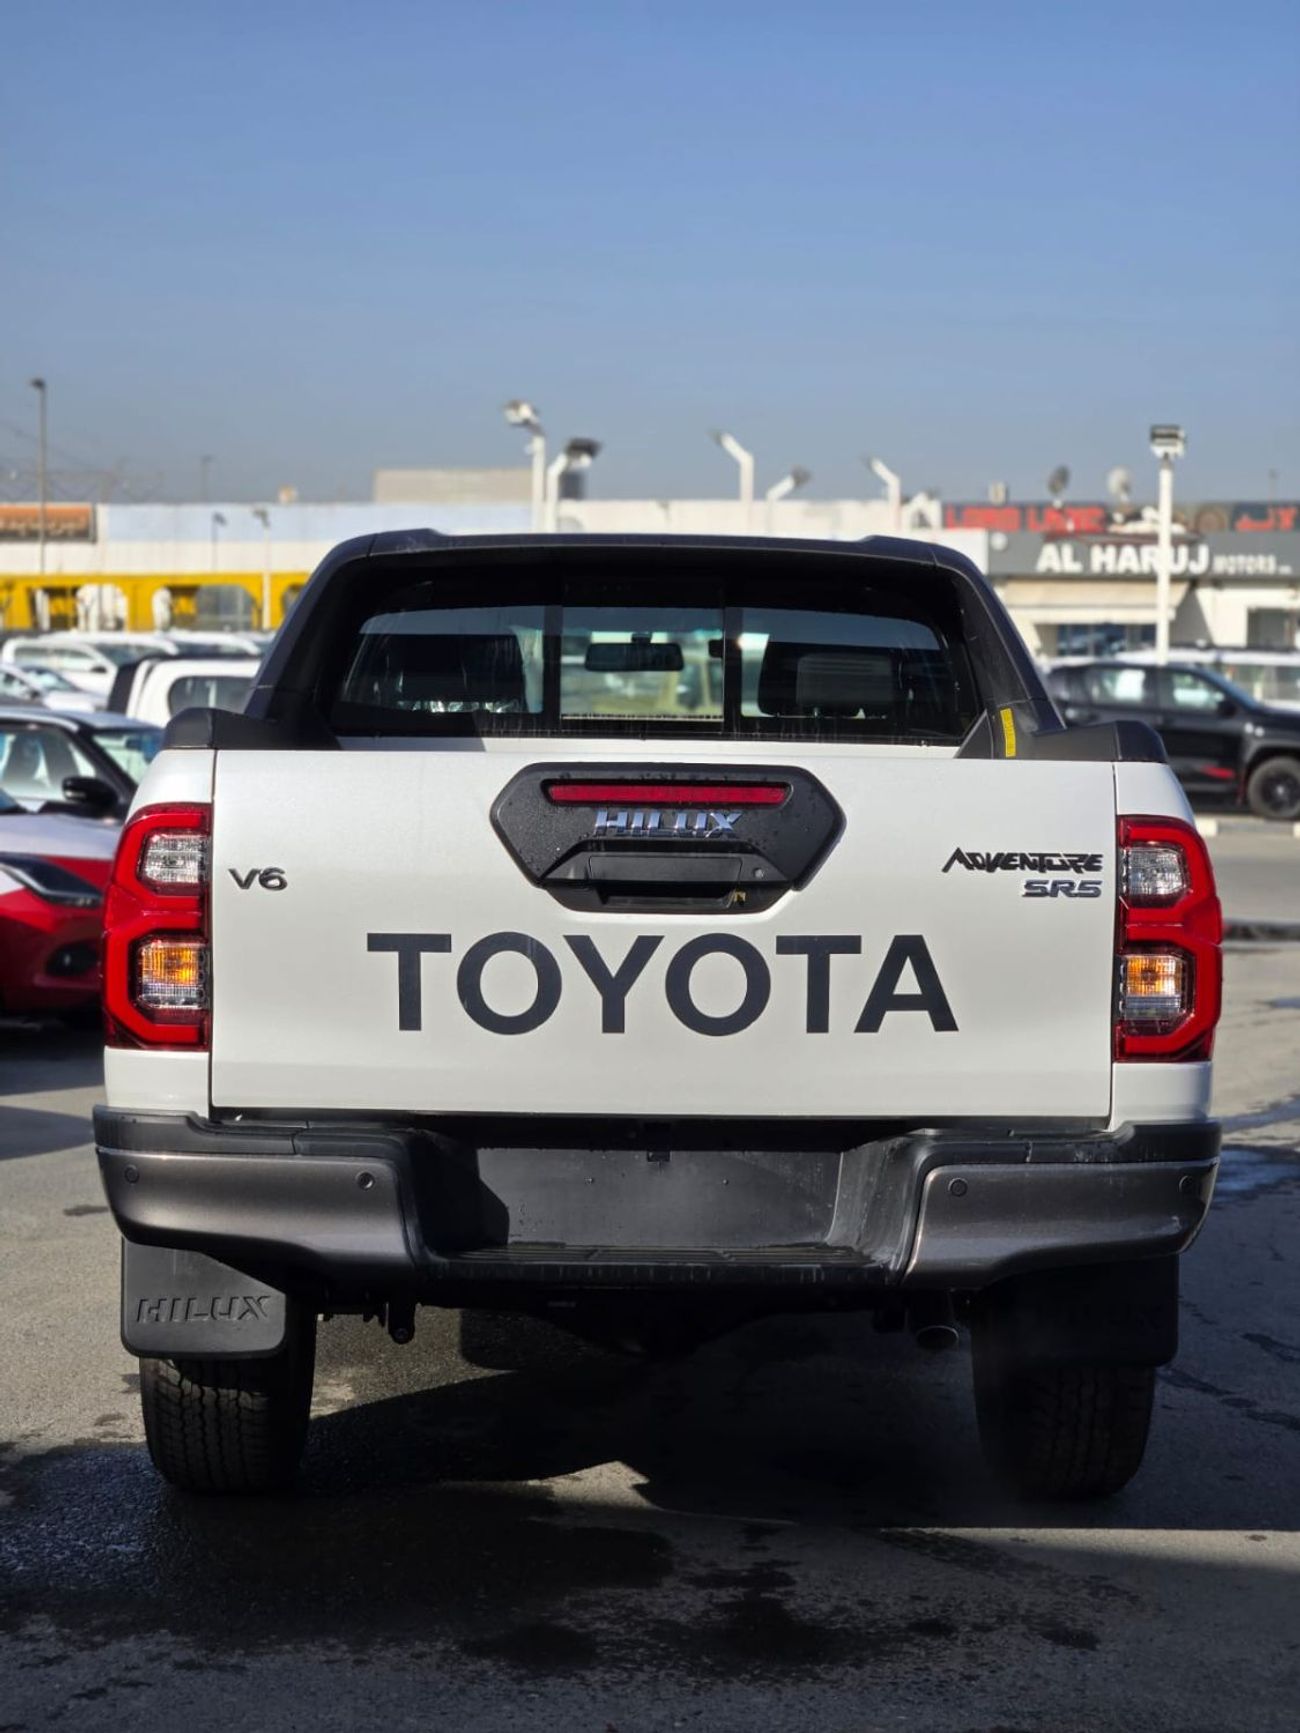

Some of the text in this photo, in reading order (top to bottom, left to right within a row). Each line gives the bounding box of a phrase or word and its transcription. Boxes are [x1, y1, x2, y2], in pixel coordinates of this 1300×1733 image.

[1036, 544, 1082, 574] AL
[594, 809, 742, 838] HILUX
[942, 847, 1103, 874] ADVENTURE
[228, 867, 288, 891] V6
[1022, 880, 1102, 897] SR5
[367, 932, 959, 1036] TOYOTA
[137, 1295, 271, 1322] HILUX
